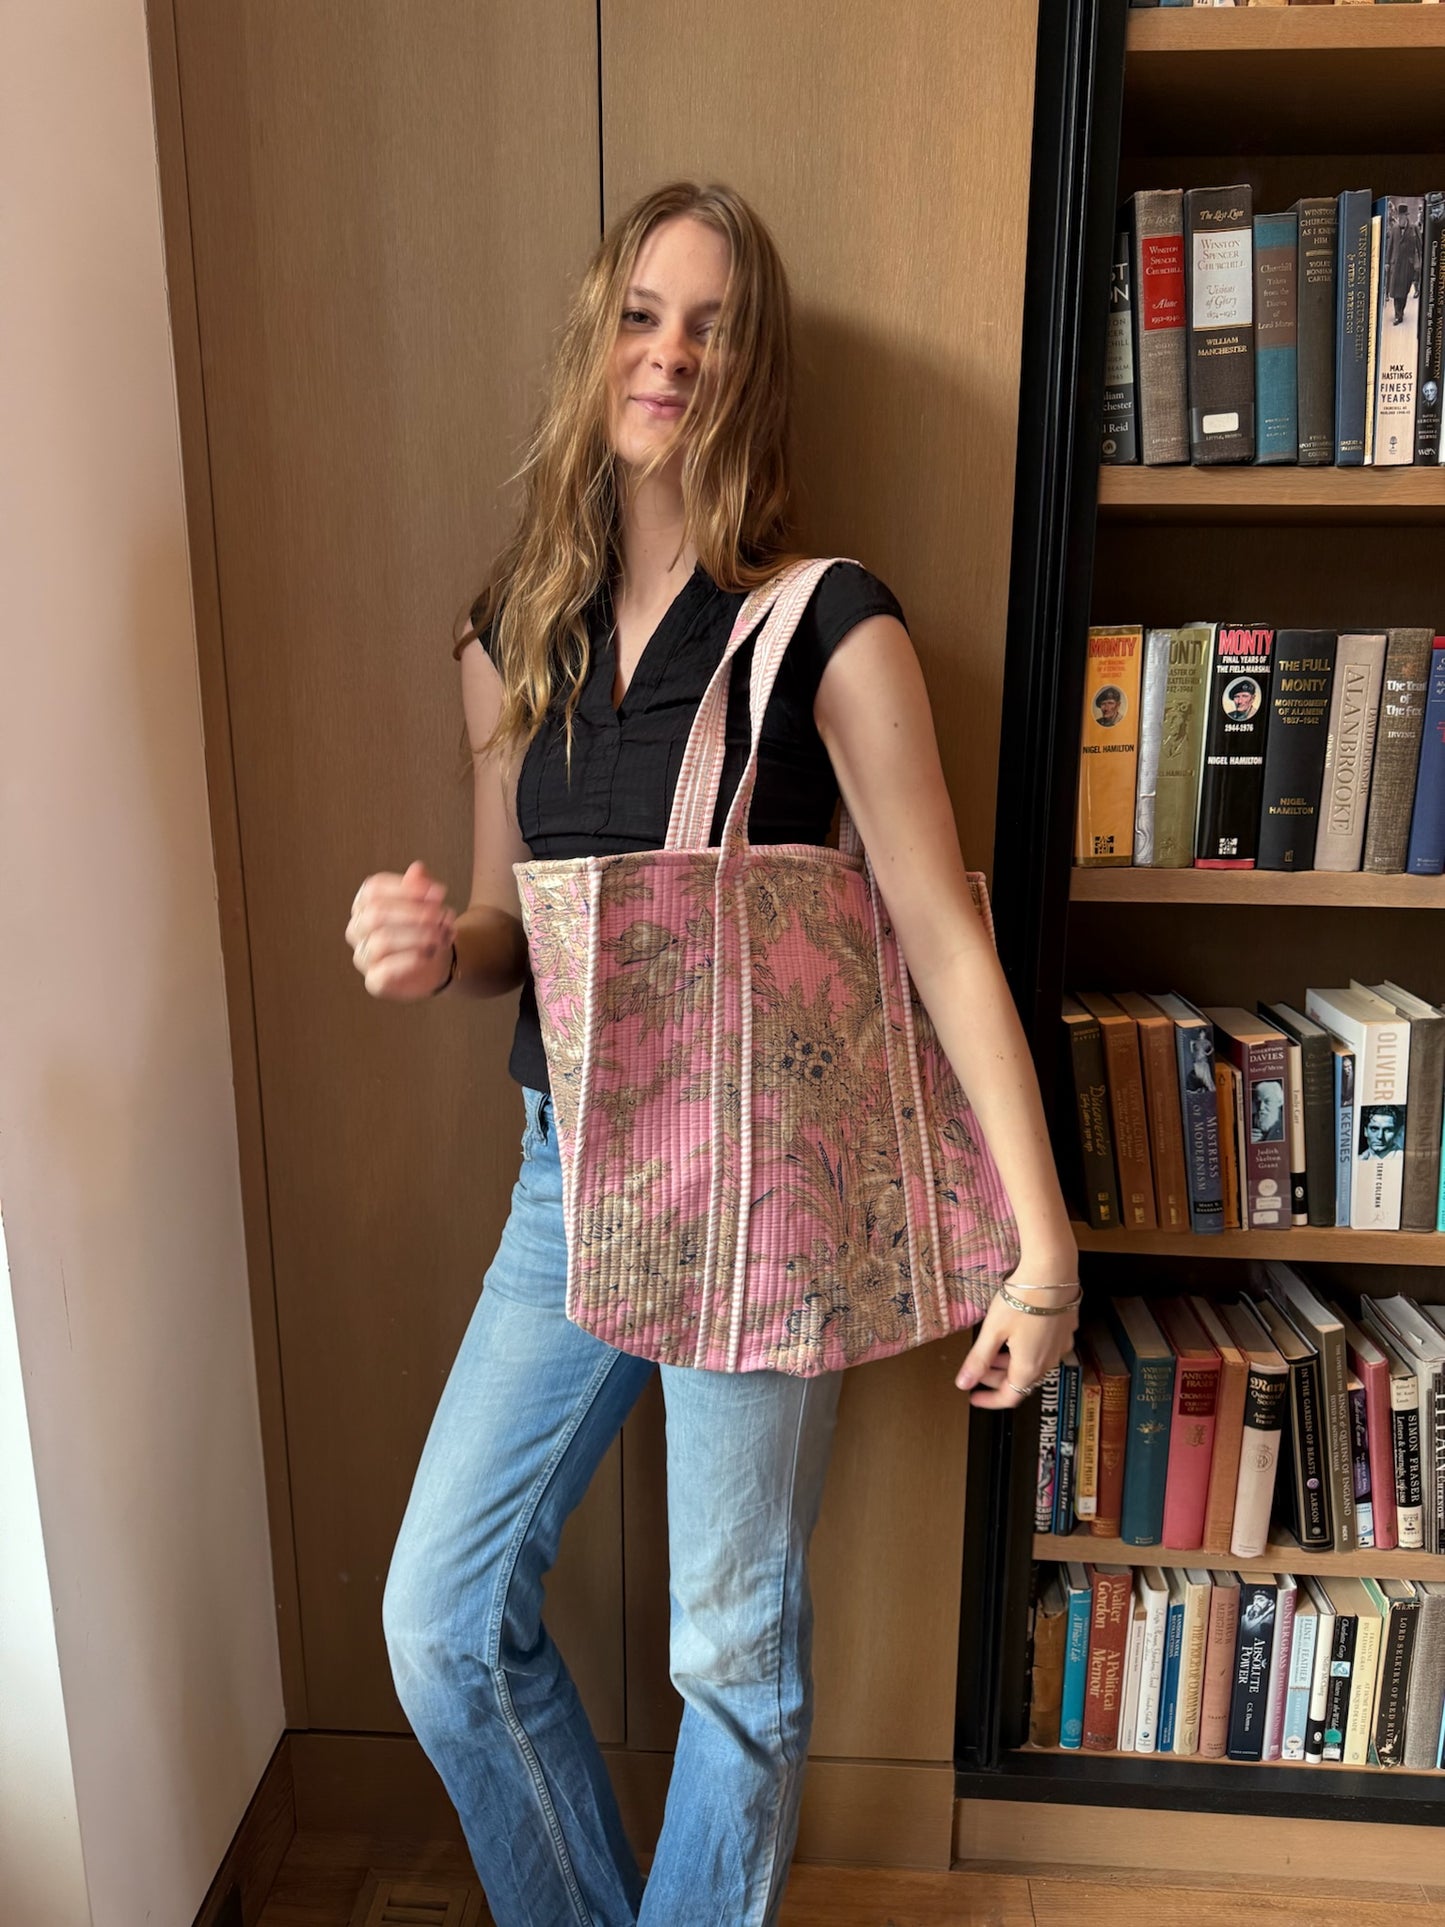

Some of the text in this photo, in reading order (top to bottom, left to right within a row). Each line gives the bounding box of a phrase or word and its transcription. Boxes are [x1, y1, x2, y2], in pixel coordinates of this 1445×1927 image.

[1200, 210, 1213, 221] The
[1302, 229, 1313, 237] AS
[1313, 236, 1328, 245] HIM
[1357, 224, 1368, 285] WINSTON
[1216, 296, 1237, 309] Glory
[1258, 319, 1273, 330] Lord
[1198, 345, 1248, 357] MANCHESTER
[1206, 336, 1239, 346] WILLIAM
[1433, 316, 1444, 379] WASHINGTON
[1381, 383, 1413, 393] FINEST
[1381, 394, 1411, 402] YEARS
[1109, 422, 1129, 433] Reid
[1089, 637, 1138, 658] MONTY
[1218, 629, 1274, 656] MONTY
[1217, 665, 1270, 673] THE FIELD-MARSHAL
[1222, 655, 1267, 664] FINAL YEARS OF
[1279, 659, 1331, 671] THE FULL
[1281, 679, 1327, 691] MONTY
[1387, 681, 1406, 691] The
[1275, 699, 1328, 707] MONTGOMERY
[1400, 694, 1412, 704] of
[1278, 708, 1289, 716] OF
[1386, 704, 1406, 716] The
[1082, 744, 1135, 754] NIGEL HAMILTON
[1332, 671, 1364, 831] ALANBROOKE
[1360, 707, 1378, 794] DAVID FRASER
[1207, 756, 1263, 765] NIGEL HAMILTON
[1269, 806, 1314, 815] HAMILTON
[1280, 798, 1307, 806] NIGEL
[1250, 1052, 1284, 1062] DAVIES
[1374, 1032, 1397, 1102] OLIVIER
[1205, 1116, 1218, 1178] MISTRESS
[1340, 1112, 1352, 1163] KEYNES
[1193, 1121, 1207, 1190] MODERNISM
[1375, 1163, 1384, 1208] TERRY COLEMAN
[1250, 1377, 1285, 1393] Mary
[1337, 1393, 1347, 1419] KINGS
[1301, 1368, 1316, 1475] IN THE GARDEN OF BEASTS
[1397, 1416, 1406, 1440] Letters
[1039, 1416, 1057, 1453] PAGE
[1408, 1415, 1418, 1451] SIMON
[1339, 1430, 1349, 1461] QUEENS
[1341, 1463, 1350, 1474] OF
[1410, 1457, 1420, 1502] FRASER
[1342, 1476, 1353, 1516] ENGLAND
[1310, 1492, 1320, 1524] LARSON
[1094, 1580, 1113, 1629] Gordon
[1110, 1582, 1128, 1625] Walter
[1192, 1624, 1205, 1641] THE
[1214, 1602, 1227, 1645] MEIGHEN
[1225, 1602, 1236, 1645] ARTHUR
[1363, 1622, 1369, 1631] DU
[1299, 1618, 1313, 1682] FLINT FEATHER
[1336, 1644, 1347, 1659] Gray
[1366, 1632, 1375, 1662] FRANCINE
[1090, 1648, 1107, 1698] Memoir
[1238, 1645, 1254, 1685] POWER
[1248, 1638, 1266, 1694] ABSOLUTE
[1388, 1617, 1408, 1720] LORD SELKIRK OF RED
[1103, 1650, 1121, 1711] A Political
[1365, 1682, 1371, 1690] AT
[1184, 1682, 1201, 1725] COMMAND
[1353, 1685, 1362, 1710] MARQUIS
[1363, 1690, 1371, 1707] HOME
[1361, 1708, 1369, 1723] WITH
